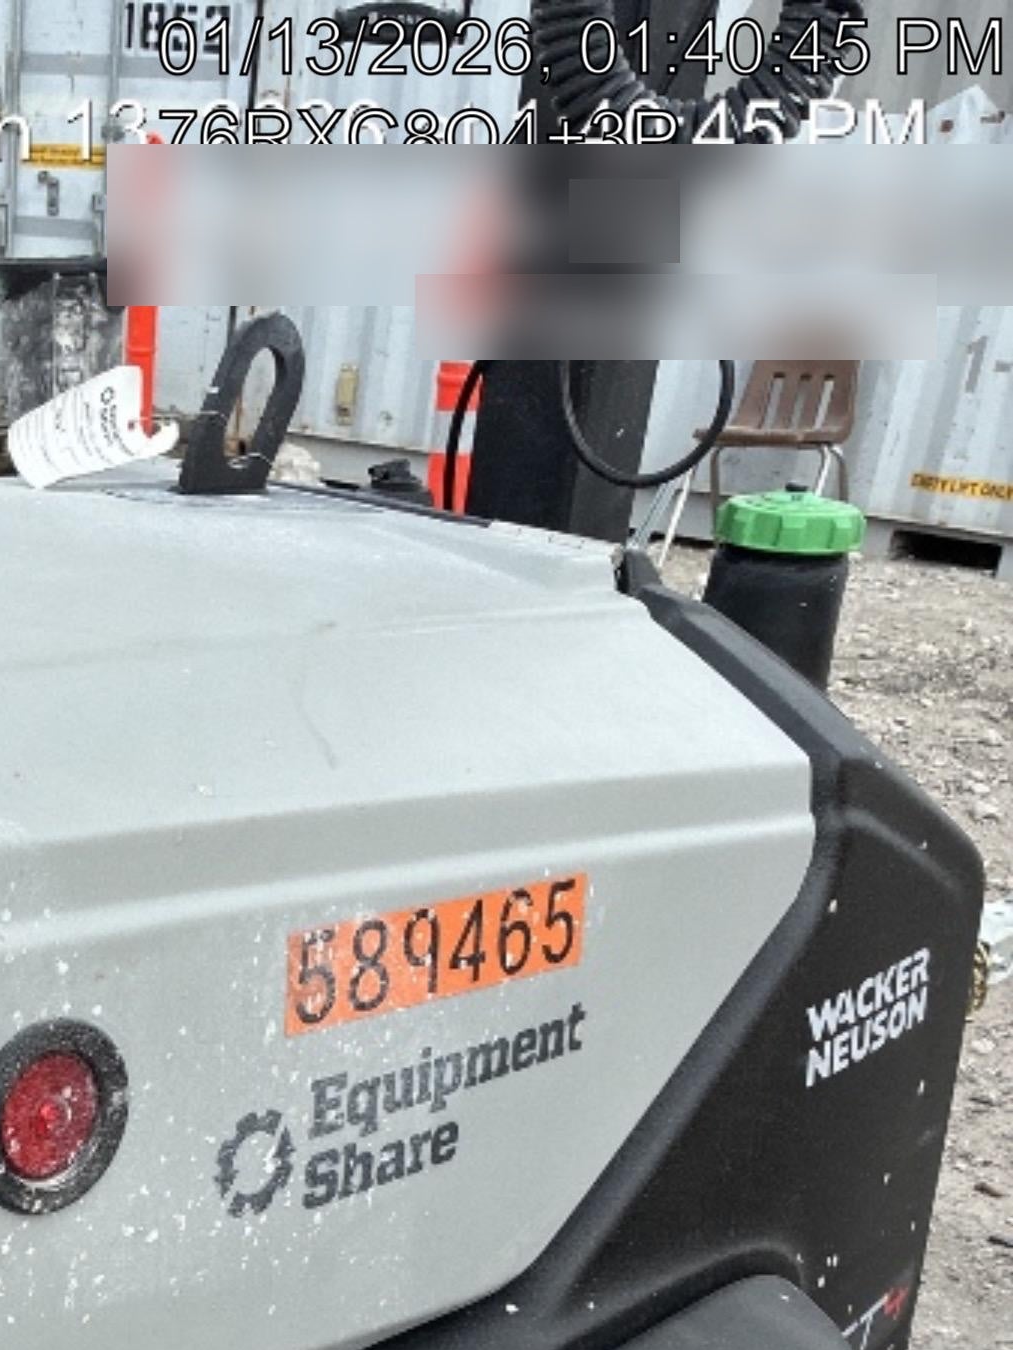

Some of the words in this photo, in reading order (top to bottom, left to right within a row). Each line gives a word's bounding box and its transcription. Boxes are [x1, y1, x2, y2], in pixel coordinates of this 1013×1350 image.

[295, 878, 577, 1025] 589465
[805, 947, 931, 1042] WACKER
[309, 1002, 587, 1140] Equipment
[804, 986, 929, 1087] NEUSON
[302, 1120, 459, 1210] Share
